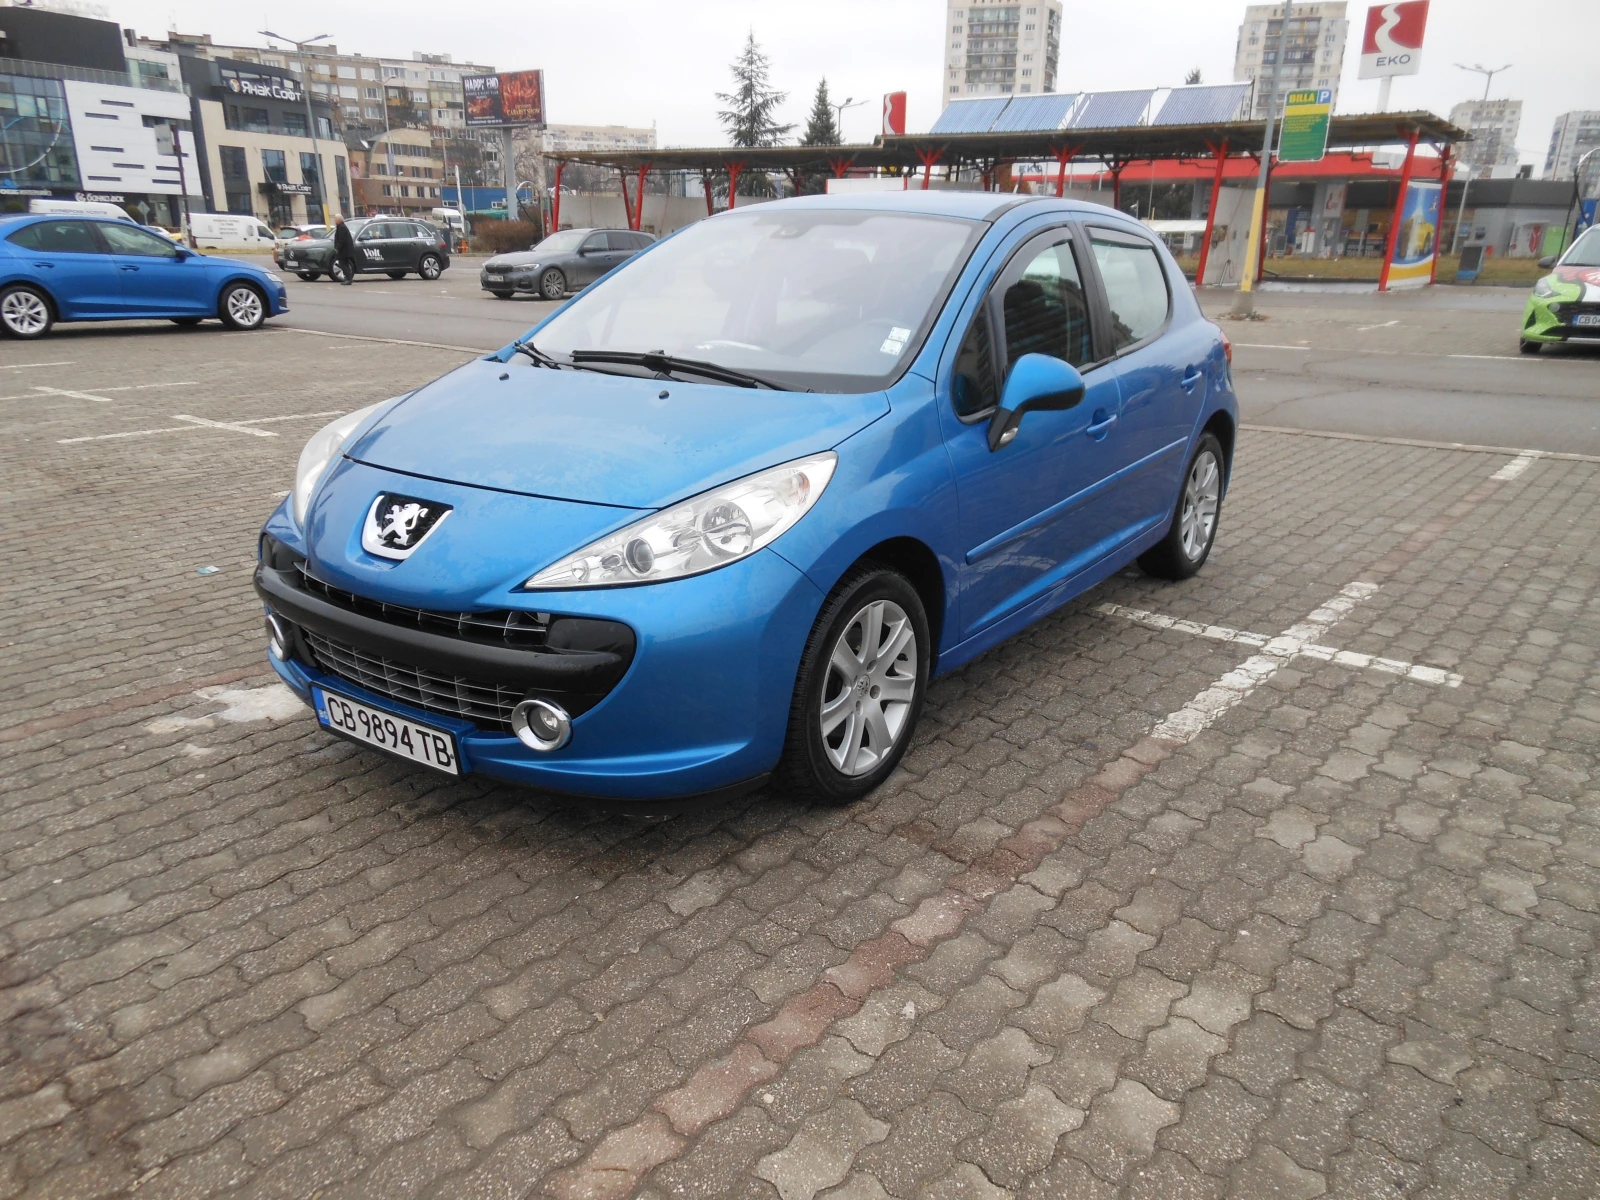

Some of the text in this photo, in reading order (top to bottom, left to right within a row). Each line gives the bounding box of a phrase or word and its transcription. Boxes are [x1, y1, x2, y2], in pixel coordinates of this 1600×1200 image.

[1376, 54, 1411, 67] EKO
[464, 77, 499, 91] HAPPY END
[241, 80, 302, 102] Янак Софт
[1320, 91, 1330, 103] P
[1289, 92, 1315, 103] BILLA
[1019, 164, 1043, 173] EKO
[363, 248, 381, 258] Volt
[357, 709, 414, 756] 9894
